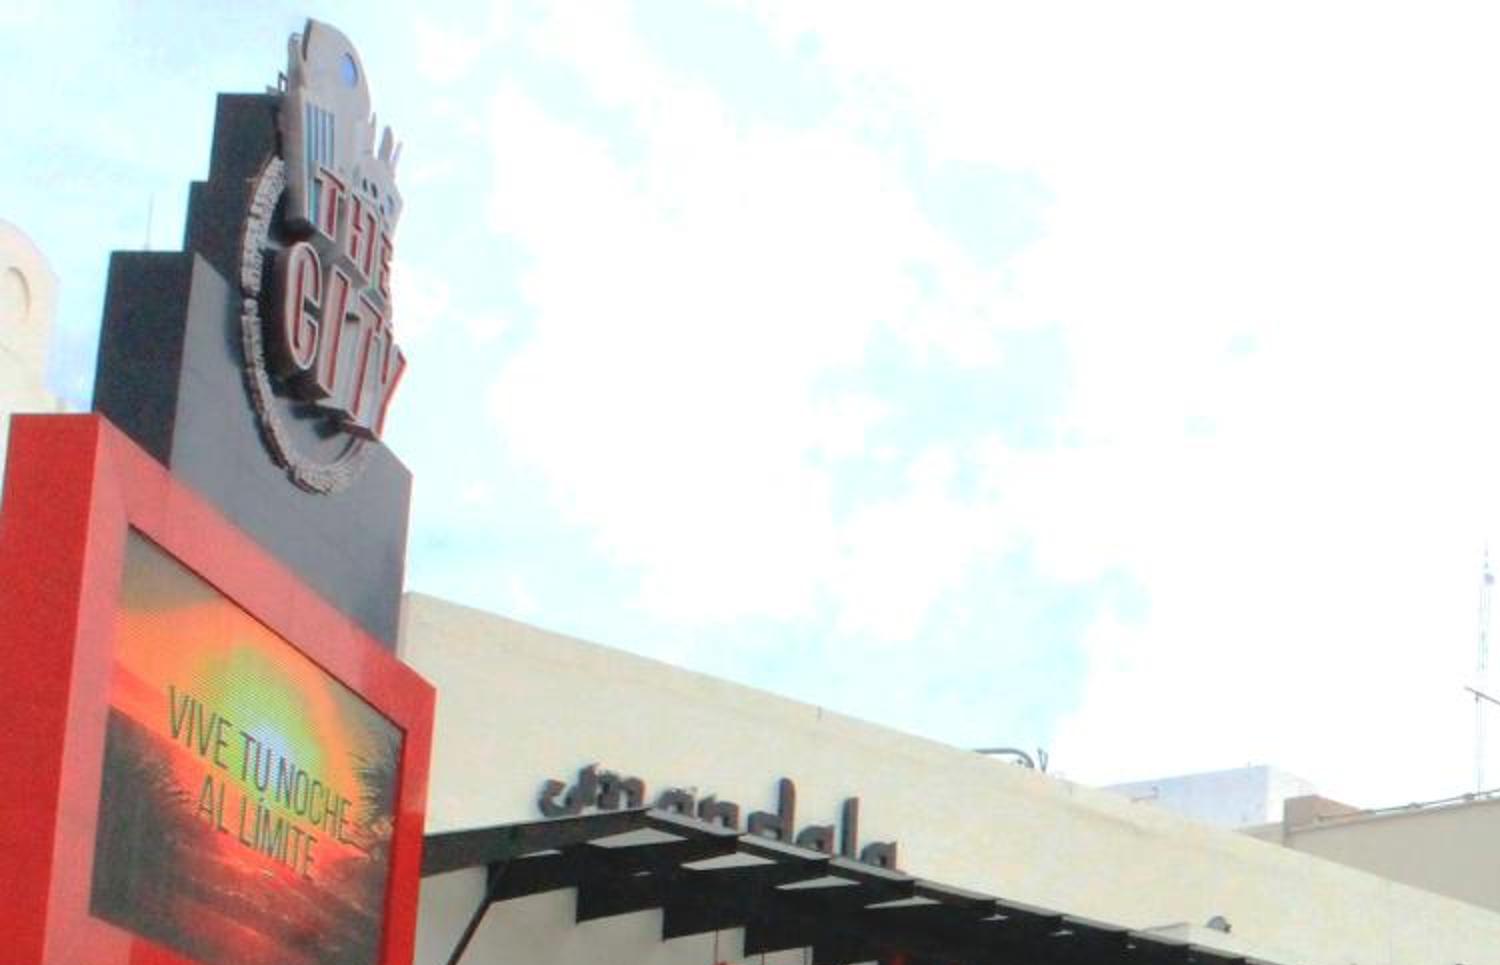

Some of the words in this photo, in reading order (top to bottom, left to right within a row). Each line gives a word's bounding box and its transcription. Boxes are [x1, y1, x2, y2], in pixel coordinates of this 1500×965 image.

[313, 166, 393, 300] THE
[286, 241, 407, 441] CITY
[168, 684, 233, 771] VIVE
[240, 730, 272, 792] TU
[275, 756, 352, 845] NOCHE
[199, 774, 230, 835] AL
